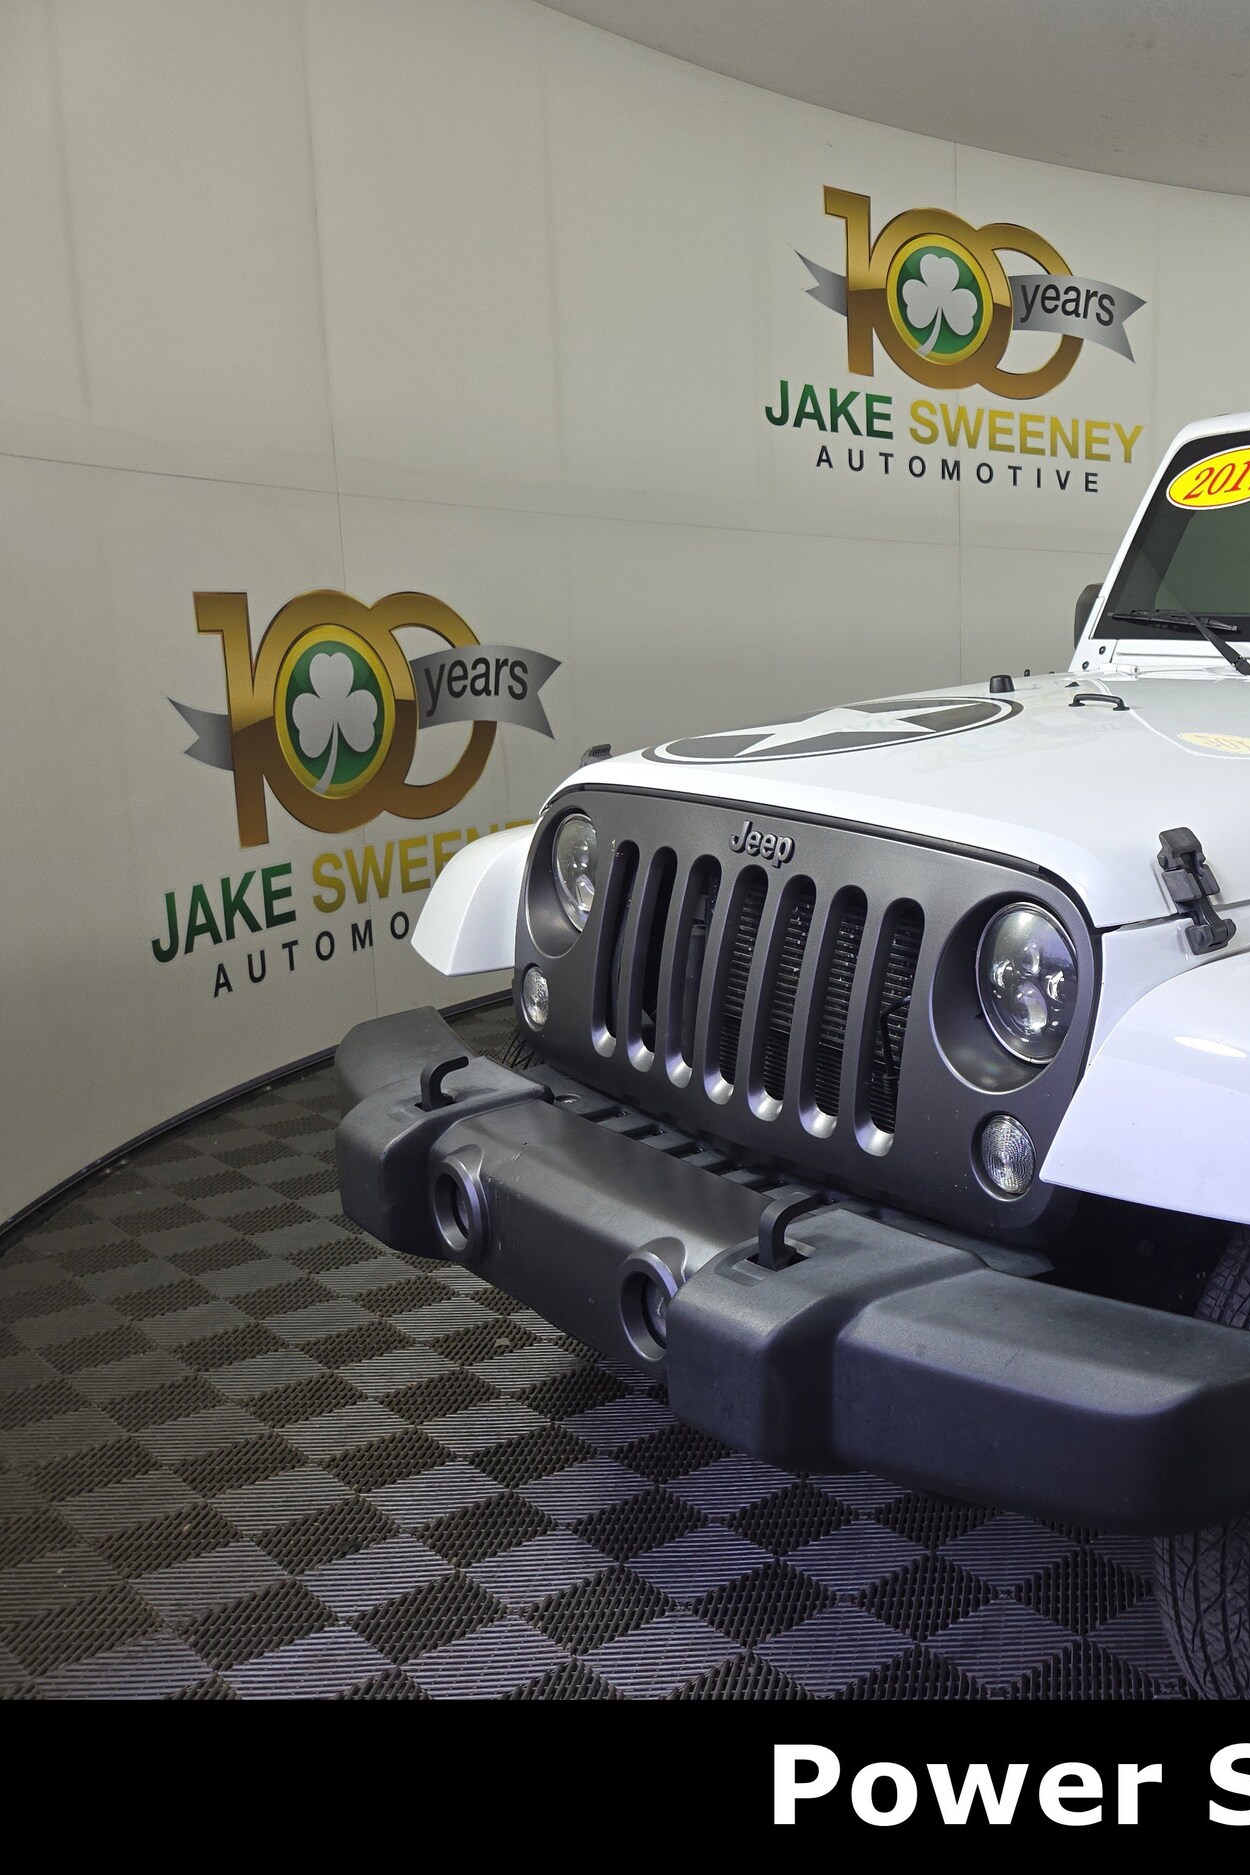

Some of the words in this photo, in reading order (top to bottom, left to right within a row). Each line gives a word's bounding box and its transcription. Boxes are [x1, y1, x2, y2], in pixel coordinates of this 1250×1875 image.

[823, 185, 1084, 400] 100
[1019, 280, 1116, 328] years
[765, 379, 894, 440] JAKE
[908, 399, 1145, 465] SWEENEY
[815, 445, 1099, 493] AUTOMOTIVE
[193, 589, 498, 848] 100
[423, 655, 530, 718] years
[728, 820, 796, 869] Jeep
[151, 862, 297, 964] JAKE
[311, 817, 535, 914] SWEE
[213, 911, 410, 998] AUTOMO
